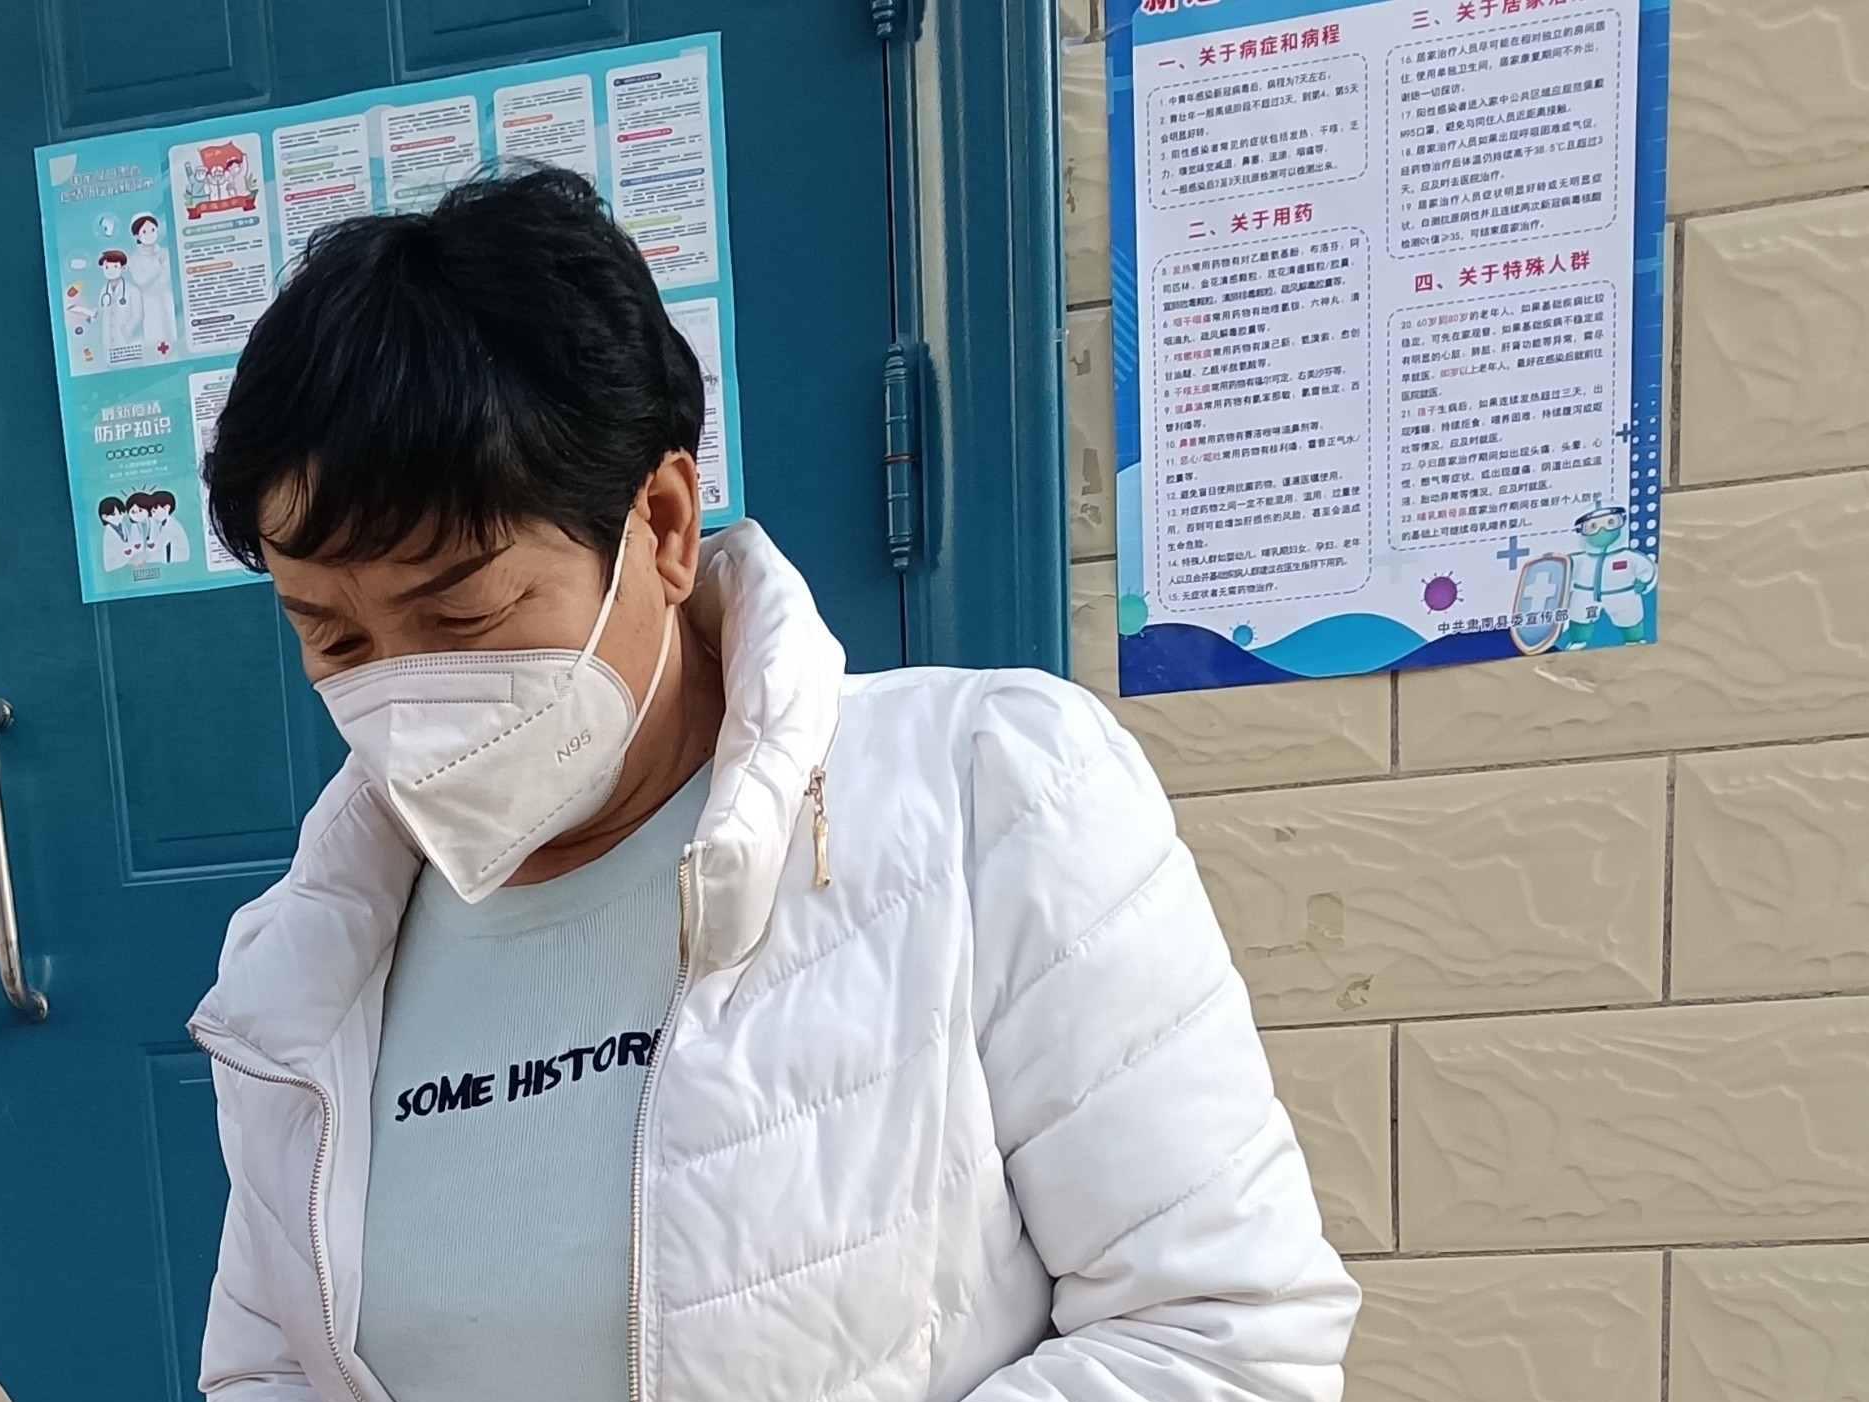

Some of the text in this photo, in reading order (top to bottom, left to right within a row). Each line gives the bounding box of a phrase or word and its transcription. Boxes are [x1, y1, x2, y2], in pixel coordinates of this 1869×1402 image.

[1412, 0, 1583, 30] 三、关于居家
[1158, 23, 1340, 69] 一、关于病症和病程
[1188, 202, 1312, 238] 二、关于用药
[1415, 249, 1590, 293] 四、关于特殊人群
[556, 729, 592, 764] N95
[395, 1073, 495, 1121] SOME
